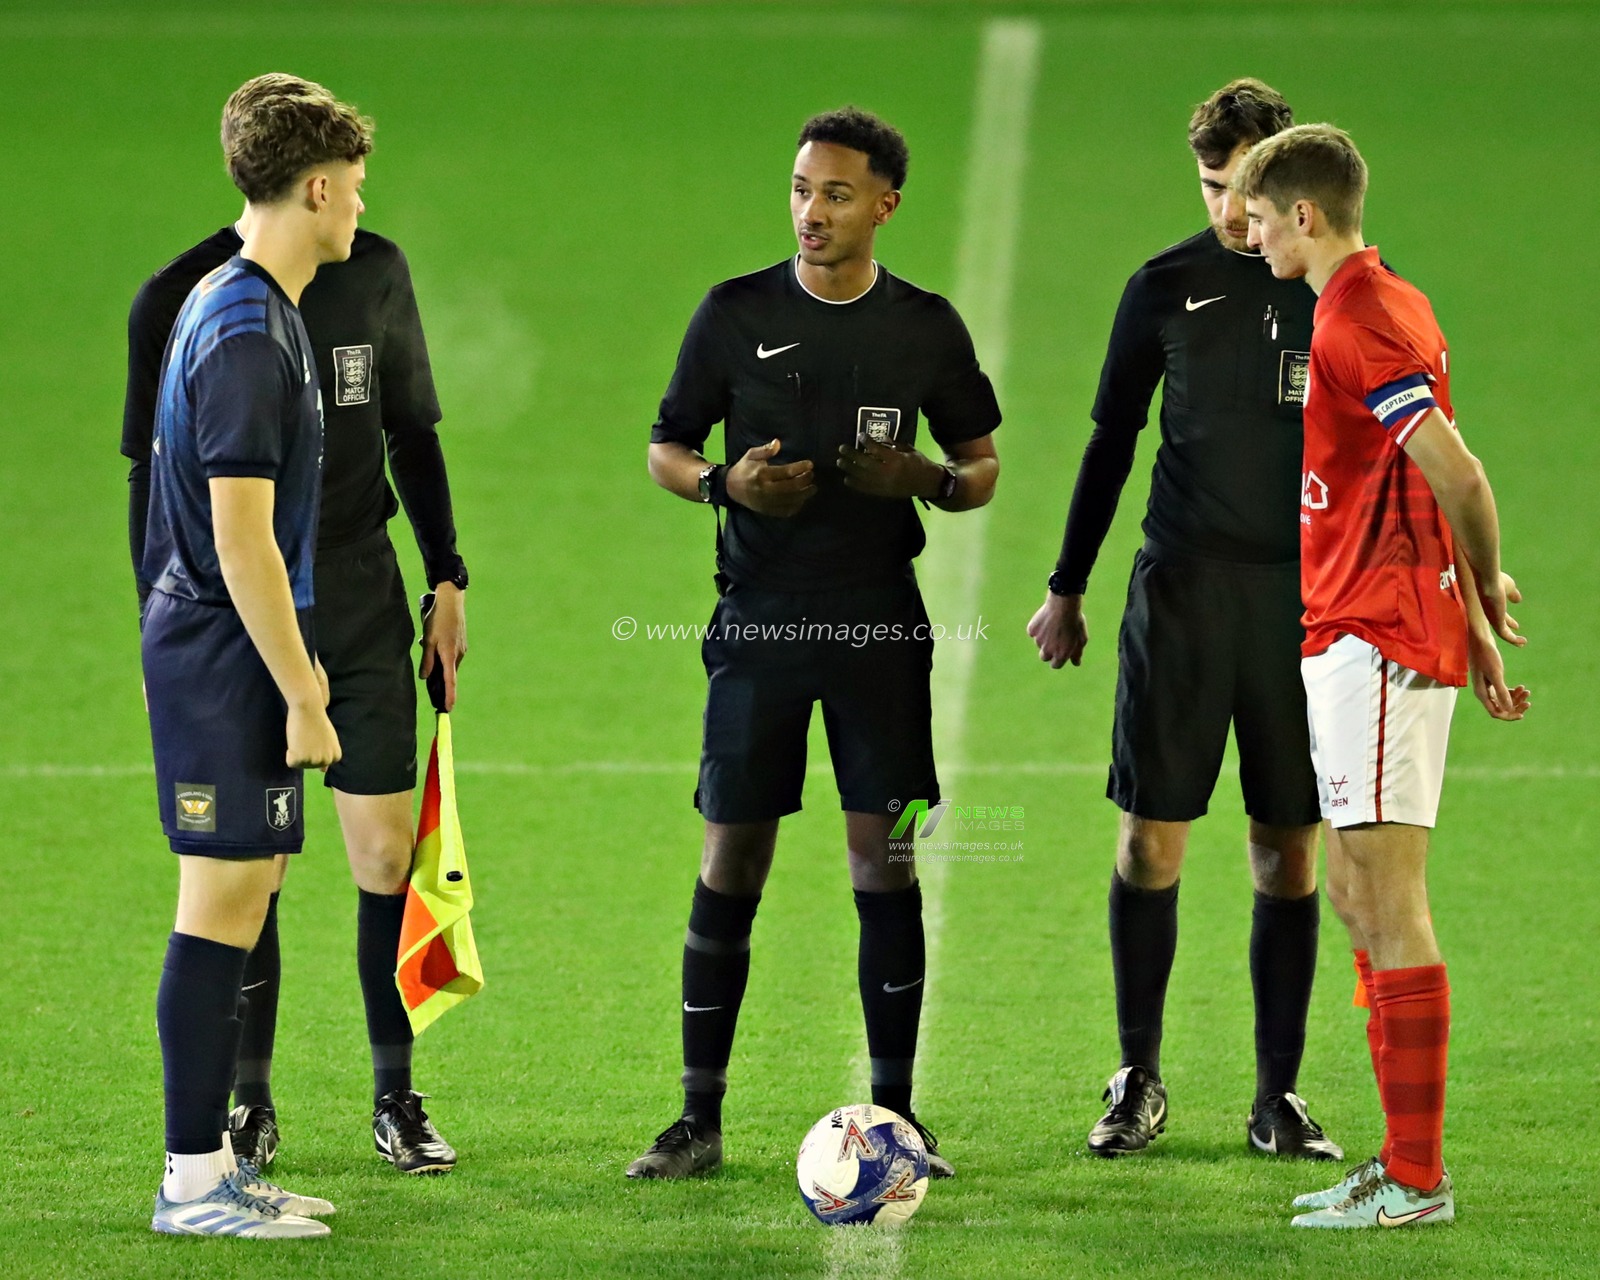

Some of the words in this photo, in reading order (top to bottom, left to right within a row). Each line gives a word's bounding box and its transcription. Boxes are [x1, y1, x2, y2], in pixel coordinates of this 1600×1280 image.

[344, 386, 365, 395] MATCH
[342, 394, 366, 402] OFFICIAL
[1381, 392, 1415, 413] CAPTAIN
